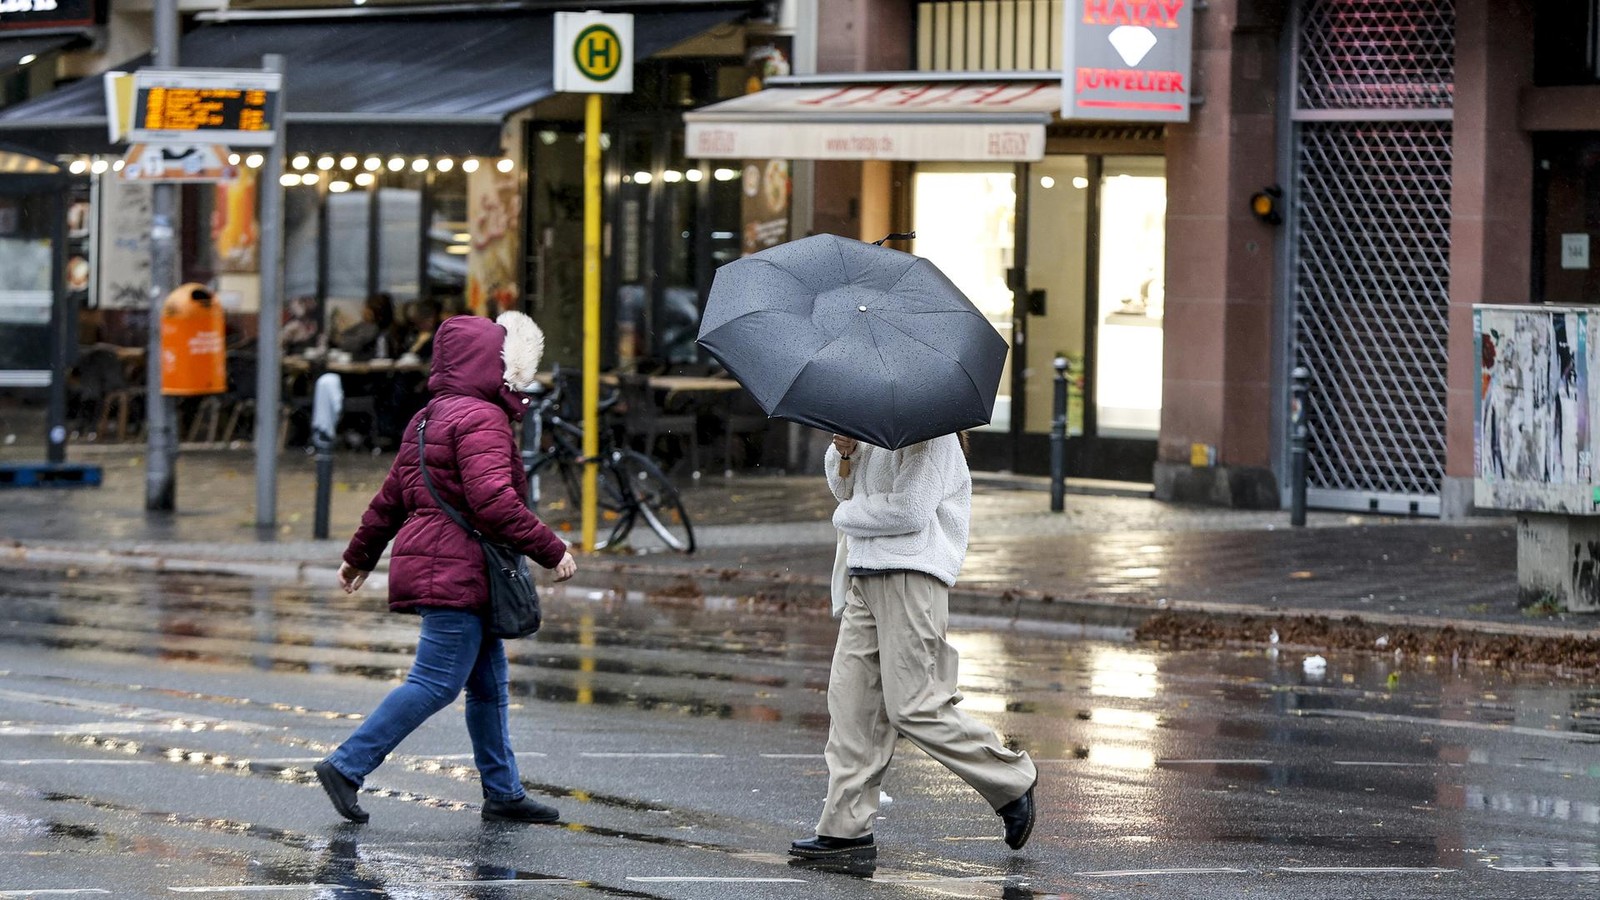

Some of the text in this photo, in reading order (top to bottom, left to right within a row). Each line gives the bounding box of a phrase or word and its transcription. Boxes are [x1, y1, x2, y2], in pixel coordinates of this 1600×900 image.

[1082, 0, 1184, 28] HATAY
[588, 38, 610, 68] H
[1076, 67, 1185, 94] JUWELIER
